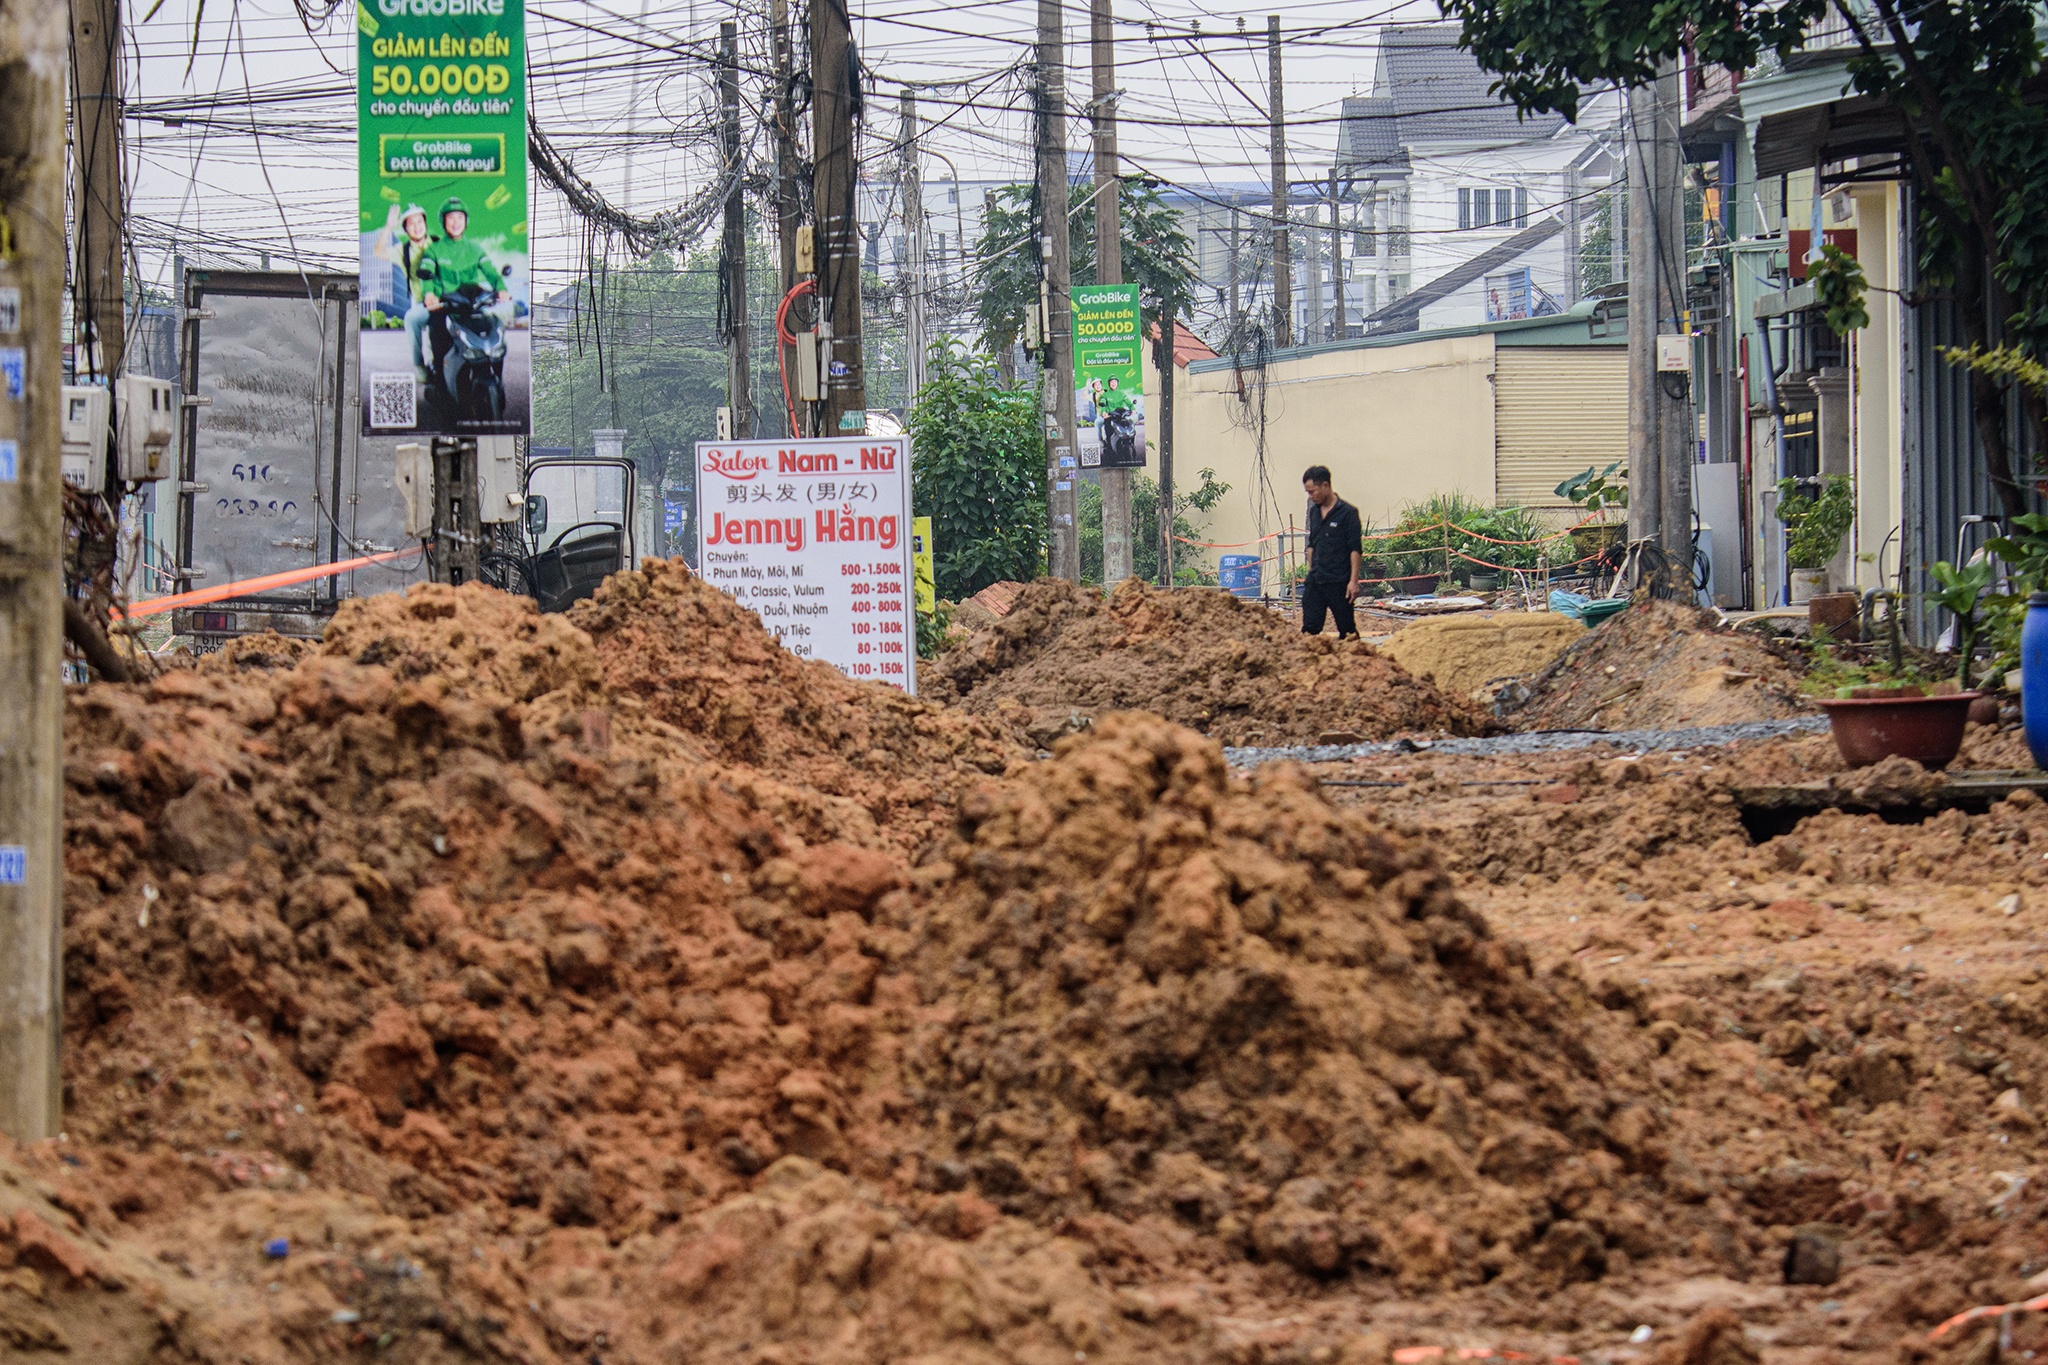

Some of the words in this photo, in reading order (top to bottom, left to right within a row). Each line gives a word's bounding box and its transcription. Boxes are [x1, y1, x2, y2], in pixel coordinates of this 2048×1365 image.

[372, 32, 425, 58] GIẢM
[429, 32, 465, 57] LÊN
[469, 30, 510, 57] ĐẾN
[372, 64, 510, 95] 50.000Đ
[370, 100, 396, 115] cho
[399, 98, 449, 118] chuyến
[452, 97, 480, 115] đầu
[413, 141, 472, 155] GrabBike
[390, 157, 415, 171] Đặt
[416, 156, 429, 170] là
[431, 156, 456, 170] đón
[458, 157, 495, 172] ngay!
[1079, 292, 1131, 304] GrabBike
[1078, 310, 1098, 320] GIẢM
[1100, 309, 1115, 320] LÊN
[1116, 308, 1133, 319] ĐẾN
[1078, 322, 1134, 335] 50.000Đ
[702, 449, 772, 480] Salon
[778, 449, 838, 473] Nam
[860, 446, 897, 471] Nữ
[726, 483, 798, 503] 剪头发
[806, 481, 878, 504] (男/女)
[706, 511, 806, 552] Jenny
[815, 503, 900, 550] Hằng
[706, 552, 749, 564] Chuyên:
[713, 567, 738, 579] Phun
[741, 565, 765, 579] Mày,
[767, 566, 789, 579] Môi,
[791, 564, 804, 577] Mí
[841, 564, 861, 576] 500
[868, 562, 901, 575] 1.500k
[733, 586, 748, 599] Mi,
[751, 585, 791, 598] Classic,
[794, 584, 825, 596] Vulum
[851, 583, 870, 595] 200
[877, 582, 902, 594] 250k
[764, 601, 790, 617] Duỗi,
[792, 603, 829, 618] Nhuộm
[851, 601, 871, 613] 400
[878, 600, 902, 612] 800k
[775, 625, 788, 637] Dự
[790, 624, 811, 638] Tiệc
[851, 622, 870, 634] 100
[879, 621, 903, 633] 180k
[202, 635, 223, 646] 61C
[794, 644, 812, 656] Gel
[857, 642, 871, 654] 80
[879, 642, 903, 653] 100k
[852, 663, 871, 675] 100
[880, 661, 904, 674] 150k
